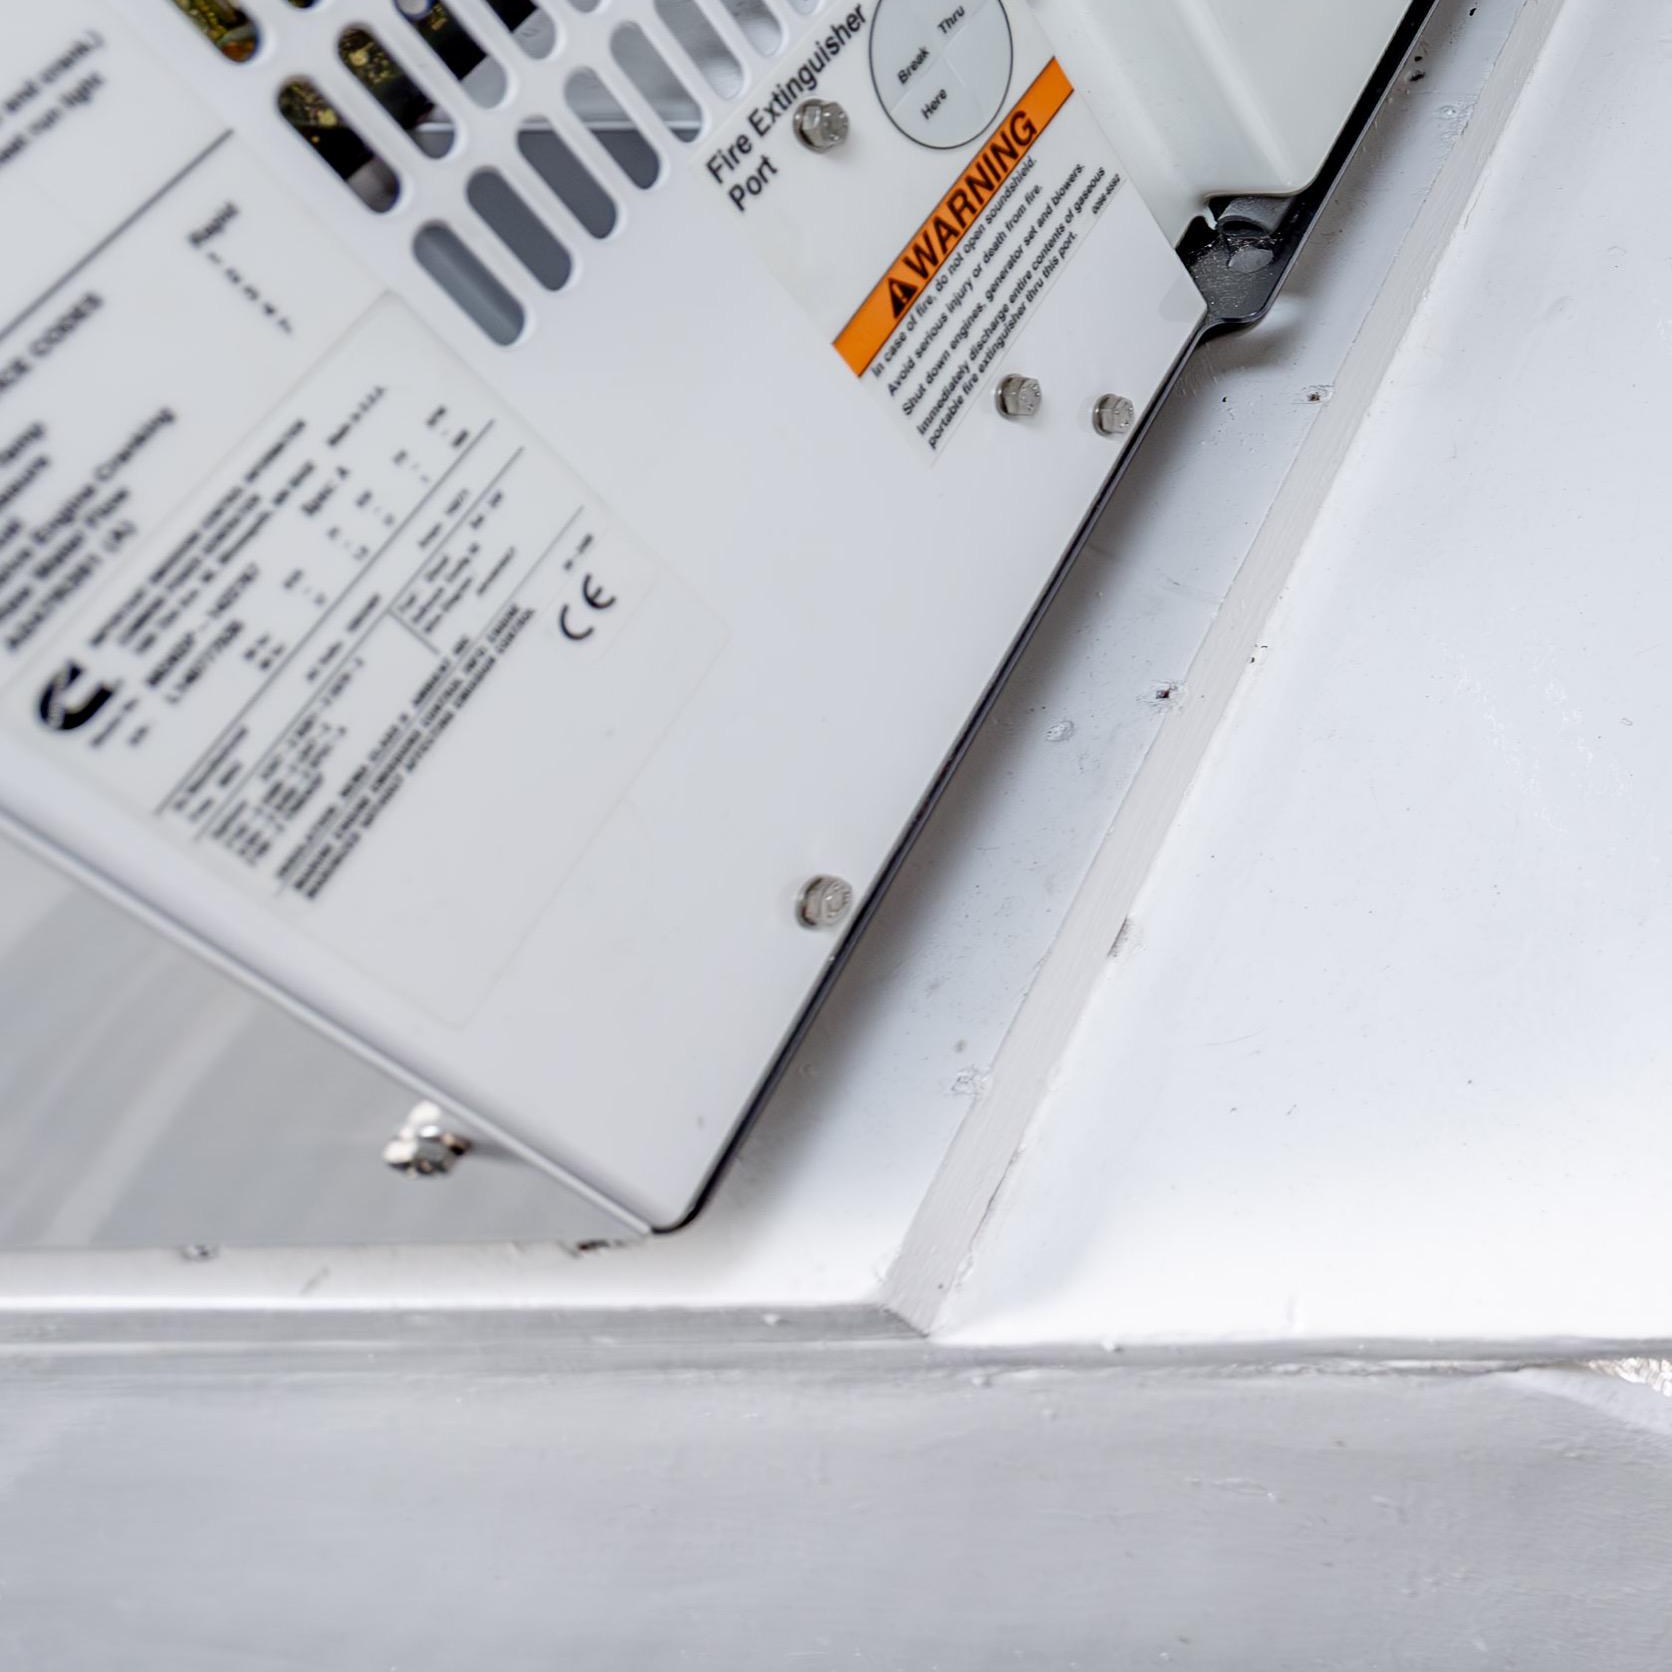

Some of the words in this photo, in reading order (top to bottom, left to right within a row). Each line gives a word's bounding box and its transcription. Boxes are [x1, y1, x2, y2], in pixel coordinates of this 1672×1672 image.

[705, 132, 753, 186] Fire
[747, 3, 868, 139] Extinguisher
[897, 46, 930, 85] Break
[936, 5, 966, 37] Thru
[921, 88, 949, 119] Here
[727, 154, 779, 212] Port
[872, 363, 884, 377] In
[885, 332, 906, 362] case
[907, 314, 917, 331] of
[936, 275, 948, 292] do
[948, 253, 963, 275] not
[964, 224, 985, 253] open
[986, 157, 1034, 224] soundshield.
[904, 111, 1037, 280] WARNING
[889, 358, 915, 396] Avoid
[915, 313, 948, 358] serious
[947, 280, 973, 313] injury
[973, 264, 982, 278] or
[984, 232, 1006, 264] death
[1005, 205, 1026, 231] from
[1025, 186, 1040, 205] fire.
[903, 385, 926, 415] Shut
[926, 351, 950, 384] down
[951, 304, 985, 350] engines,
[986, 246, 1023, 302] generator
[1024, 226, 1037, 246] set
[1037, 204, 1053, 228] and
[1051, 165, 1083, 206] blowers.
[918, 363, 970, 435] Immediately
[970, 304, 1009, 361] discharge
[1009, 271, 1032, 304] entire
[1032, 224, 1065, 271] contents
[1065, 209, 1074, 224] of
[1074, 168, 1105, 213] gaseous
[929, 396, 963, 449] portable
[963, 374, 978, 395] fire
[979, 303, 1026, 373] extinguisher
[1026, 279, 1044, 302] thru
[1042, 257, 1059, 278] this
[1059, 232, 1075, 259] port.
[31, 483, 97, 546] Engine
[95, 407, 176, 484] Cranking
[559, 574, 616, 642] CE
